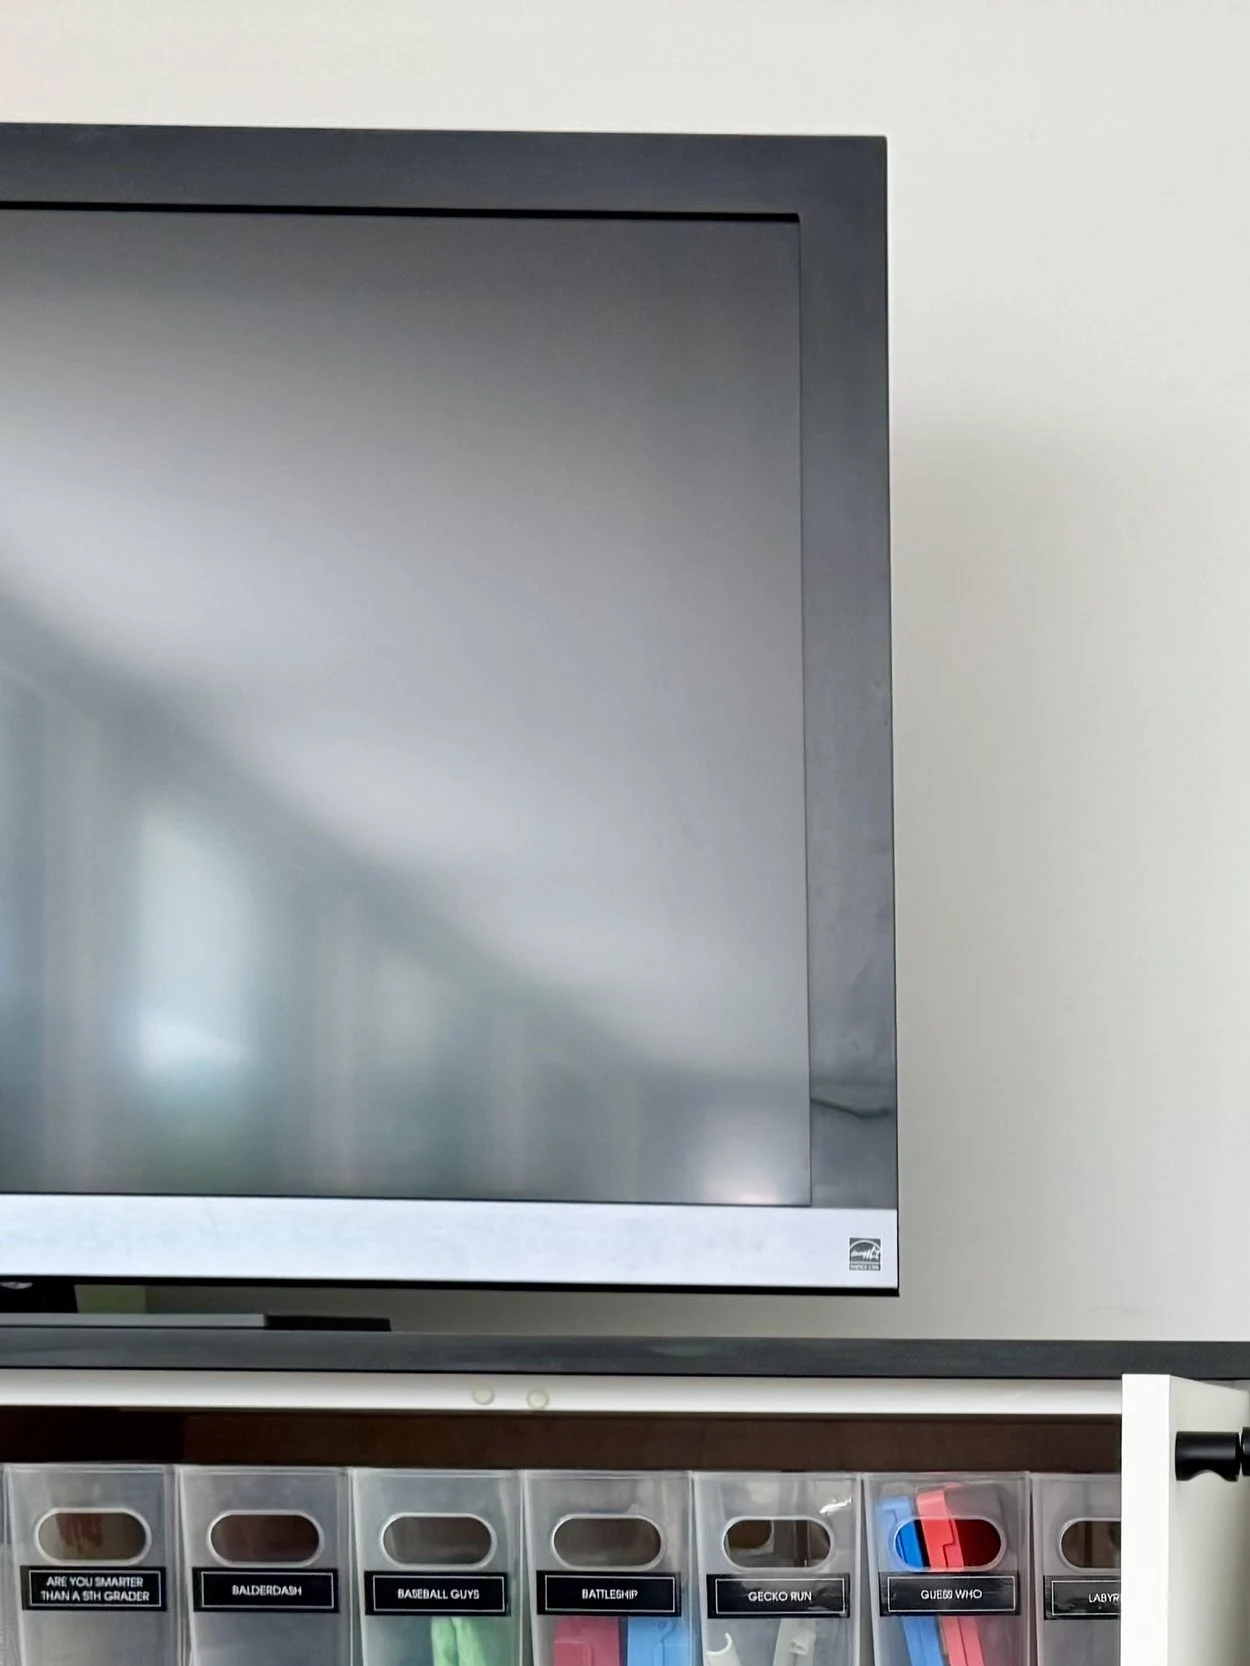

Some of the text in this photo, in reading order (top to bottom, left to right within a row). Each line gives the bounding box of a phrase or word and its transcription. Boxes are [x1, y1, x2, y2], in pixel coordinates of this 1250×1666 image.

[46, 1575, 144, 1588] ARE YOU SMARTER
[40, 1590, 70, 1602] THAN
[71, 1590, 81, 1602] A
[103, 1590, 150, 1602] GRADER
[231, 1584, 303, 1596] BALDERDASH
[397, 1588, 480, 1600] BASEBALL GUYS
[581, 1588, 639, 1600] BATTLESHIP
[920, 1588, 983, 1601] GUESS WHO
[747, 1590, 813, 1603] GECKO RUN
